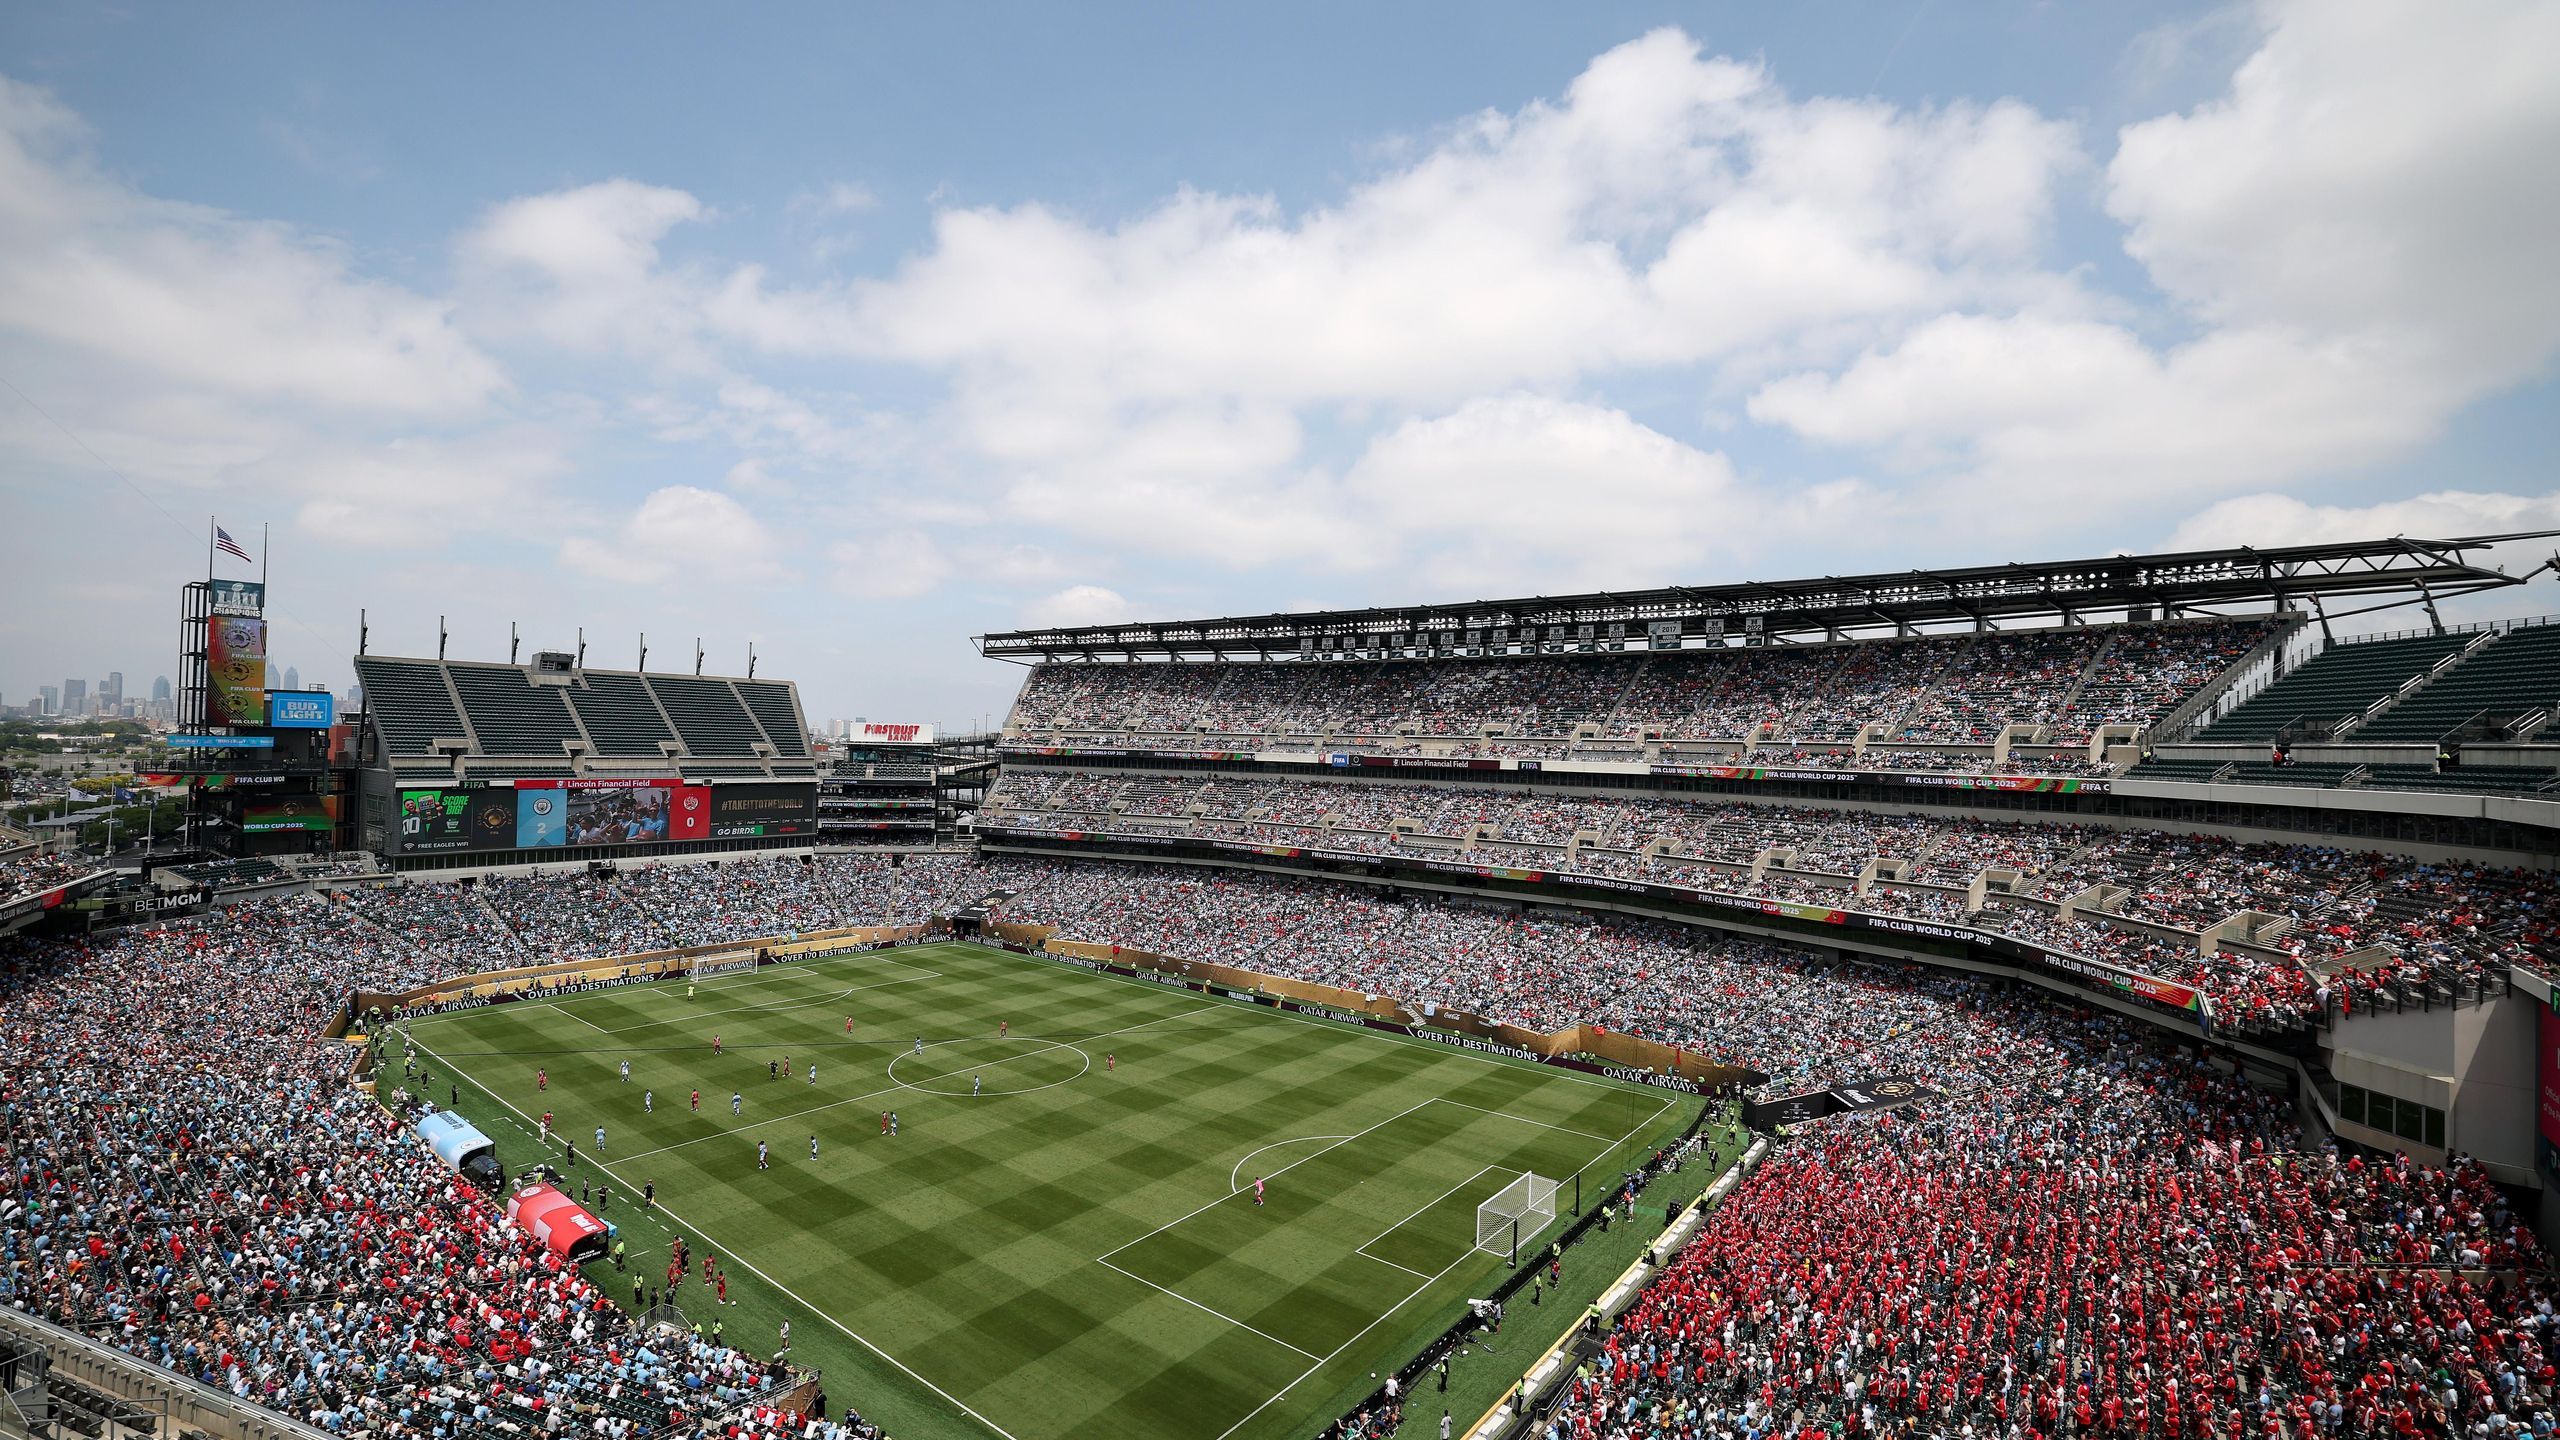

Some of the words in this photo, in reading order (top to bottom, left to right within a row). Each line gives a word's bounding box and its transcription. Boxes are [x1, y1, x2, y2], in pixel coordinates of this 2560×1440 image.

[212, 606, 261, 617] CHAMPIONS
[287, 702, 318, 710] BUD
[281, 710, 323, 719] LIGHT
[1424, 760, 1452, 768] Financial
[1521, 762, 1538, 770] FIFA
[442, 796, 469, 805] SCORE
[446, 806, 463, 815] BIG!
[687, 817, 694, 827] 0
[537, 823, 546, 833] 2
[718, 828, 730, 836] GO
[1455, 866, 1477, 874] WORLD
[1478, 868, 1491, 876] CUP
[1560, 876, 1573, 884] FIFA
[1575, 877, 1593, 885] CLUB
[1594, 878, 1614, 887] WORLD
[1616, 881, 1628, 890] CUP
[1698, 894, 1713, 903] FIFA
[1714, 897, 1732, 905] CLUB
[1734, 899, 1761, 909] WORLD
[1762, 903, 1780, 912] CUP
[4, 907, 16, 920] CLUB
[16, 903, 32, 916] WORLD
[1869, 918, 1888, 928] FIFA
[1890, 922, 1914, 932] CLUB
[1916, 925, 1951, 937] WORLD
[1954, 930, 1974, 940] CUP
[895, 938, 919, 947] QATAR
[922, 935, 950, 944] AIRWAYS
[781, 953, 802, 963] OVER
[805, 952, 817, 960] 170
[819, 944, 873, 958] DESTINATIONS
[1033, 950, 1049, 959] OVER
[2045, 954, 2061, 966] FIFA
[2062, 959, 2082, 972] CLUB
[2083, 965, 2112, 981] WORLD
[2114, 975, 2132, 986] CUP
[1136, 971, 1158, 982] QATAR
[1160, 975, 1188, 988] AIRWAYS
[528, 988, 558, 999] OVER
[561, 985, 577, 994] 170
[581, 974, 655, 992] DESTINATIONS
[1228, 991, 1254, 1002] PHILADELPHIA
[392, 1005, 434, 1018] QATAR
[440, 999, 490, 1013] AIRWAYS
[1299, 1005, 1326, 1018] QATAR
[1329, 1012, 1365, 1026] AIRWAYS
[1418, 1030, 1443, 1042] OVER
[1446, 1036, 1460, 1046] 170
[1463, 1038, 1538, 1062] DESTINATIONS
[1603, 1067, 1642, 1083] QATAR
[1647, 1076, 1699, 1094] AIRWAYS
